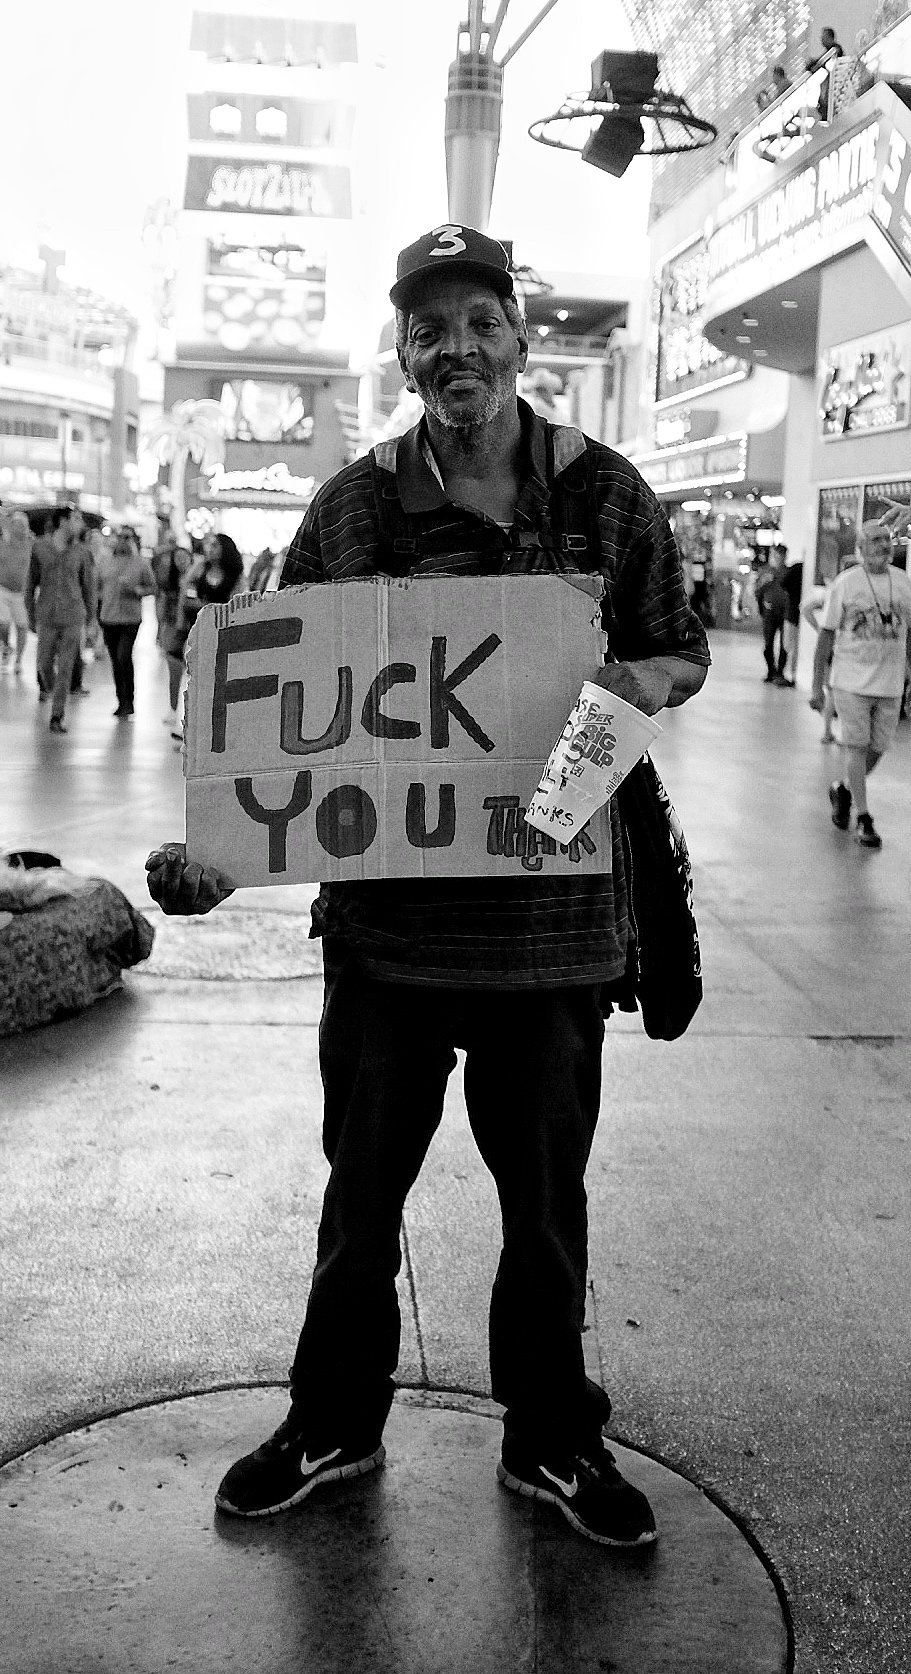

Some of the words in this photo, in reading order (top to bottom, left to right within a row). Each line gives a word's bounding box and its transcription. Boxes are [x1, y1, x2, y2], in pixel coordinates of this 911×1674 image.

[428, 225, 467, 256] 3
[211, 616, 503, 756] FUCK
[575, 713, 615, 728] SUPER
[570, 732, 614, 768] GULP
[234, 769, 457, 874] YOU
